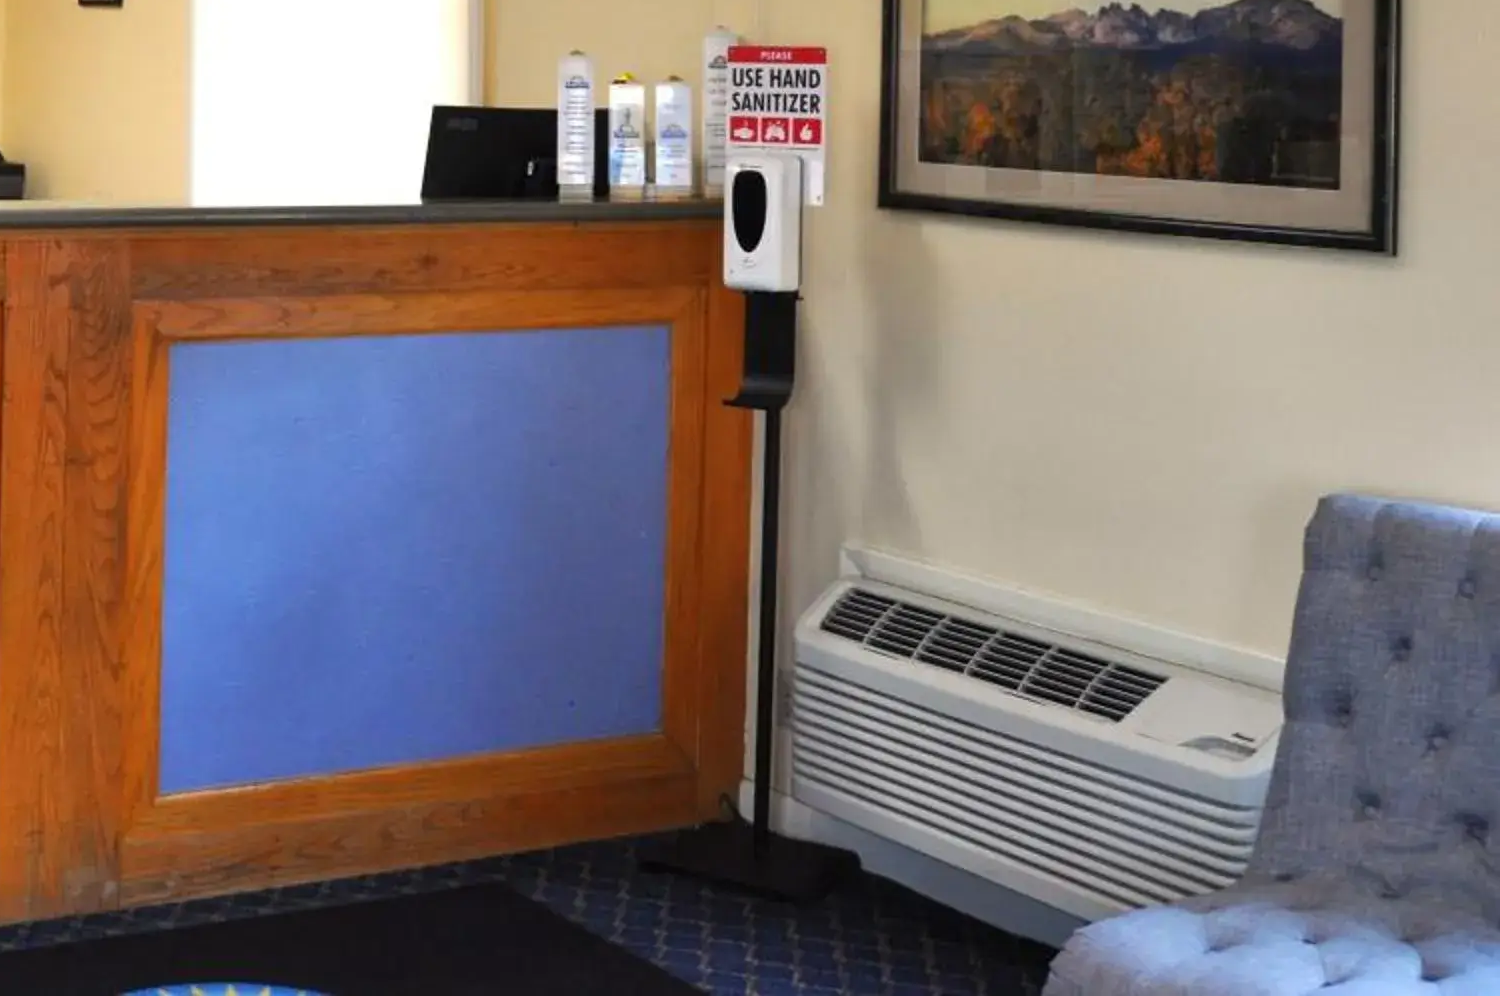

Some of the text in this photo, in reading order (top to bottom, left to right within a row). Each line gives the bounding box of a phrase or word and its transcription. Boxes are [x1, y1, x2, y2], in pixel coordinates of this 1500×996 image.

[760, 51, 793, 61] PLEASE
[731, 67, 821, 89] USE HAND
[731, 91, 821, 114] SANITIZER
